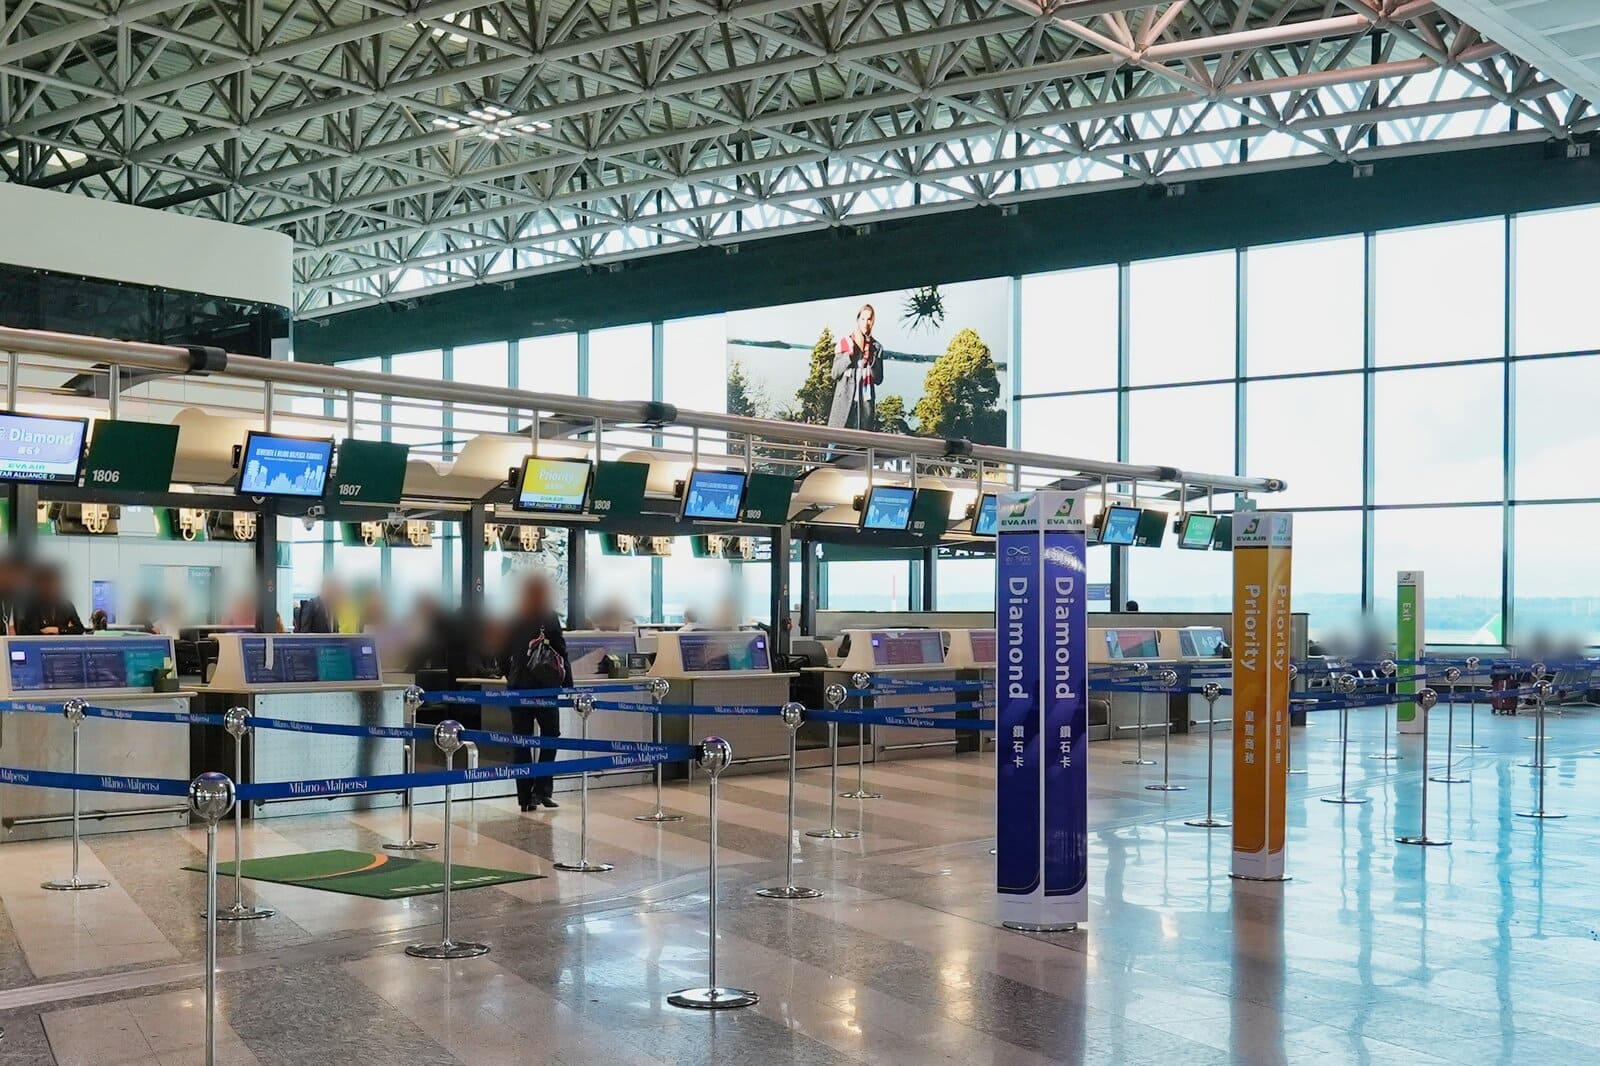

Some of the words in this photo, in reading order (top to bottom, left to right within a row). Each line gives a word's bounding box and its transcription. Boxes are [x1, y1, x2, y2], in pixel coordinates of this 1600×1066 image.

[9, 427, 74, 446] Diamond
[15, 471, 48, 479] ALLIANCE
[92, 469, 120, 483] 1806
[339, 484, 361, 496] 1807
[594, 500, 611, 510] 1808
[746, 509, 761, 519] 1809
[1402, 602, 1412, 621] Exit
[1241, 583, 1261, 672] Priority
[1274, 583, 1287, 672] Priority
[1008, 576, 1028, 699] Diamond
[1055, 576, 1075, 699] Diamond
[885, 716, 904, 725] Milano
[907, 717, 935, 727] Malpensa
[489, 732, 509, 743] Milano
[512, 734, 541, 746] Malpensa
[612, 755, 634, 766] Milano
[637, 752, 669, 764] Malpensa
[1, 768, 30, 783] Malpensa
[464, 769, 491, 780] Milano
[494, 766, 531, 779] Malpensa
[101, 776, 125, 789] Milano
[126, 778, 160, 793] Malpensa
[289, 782, 322, 793] Milano
[324, 779, 368, 792] Malpensa
